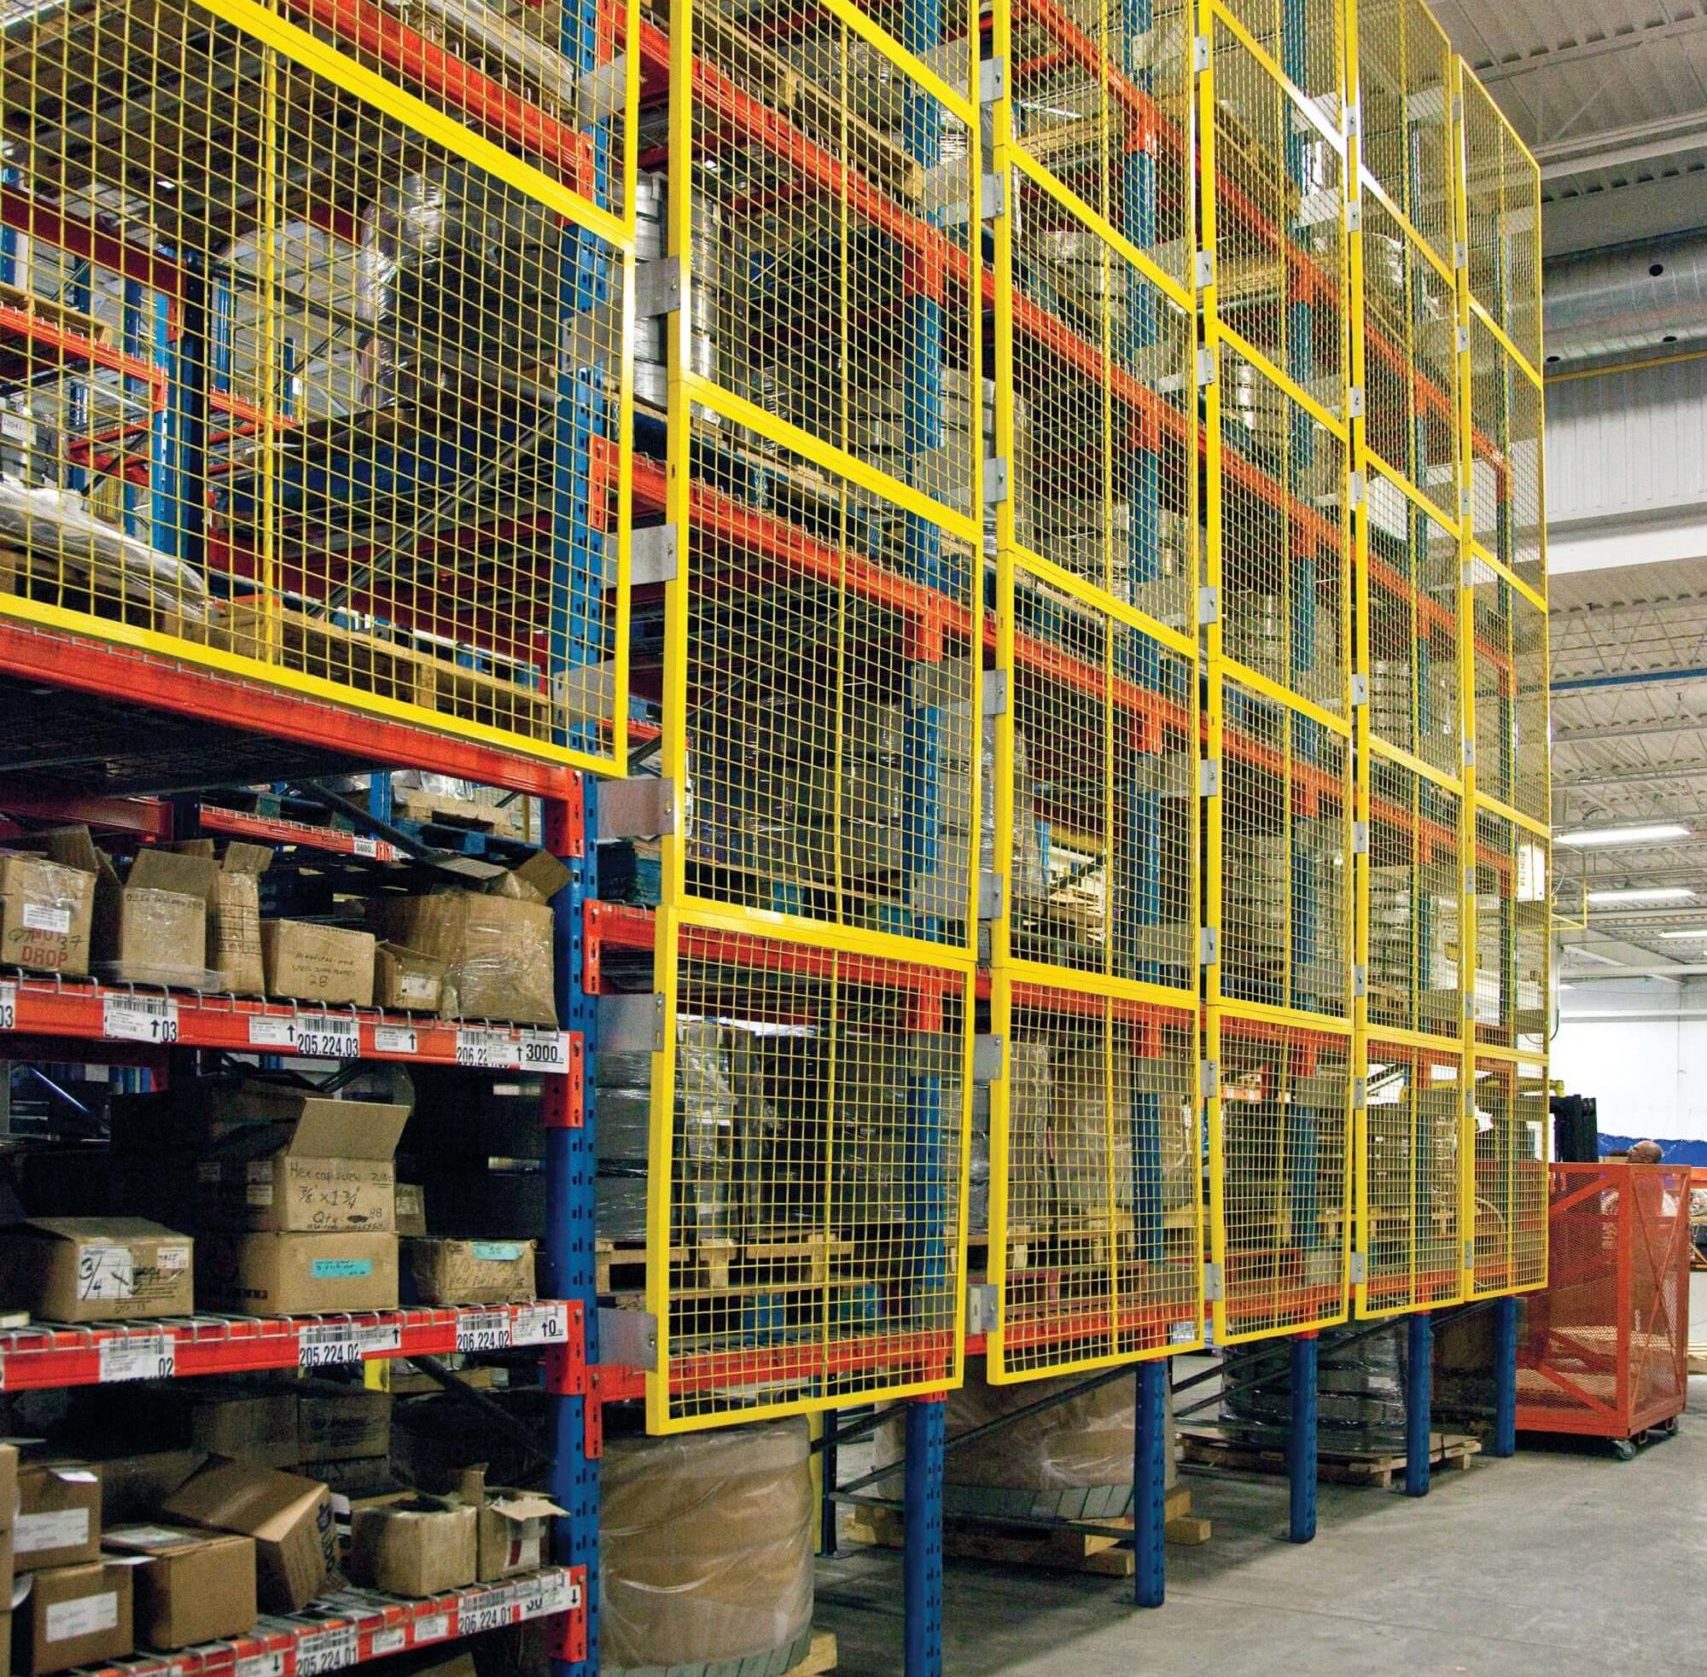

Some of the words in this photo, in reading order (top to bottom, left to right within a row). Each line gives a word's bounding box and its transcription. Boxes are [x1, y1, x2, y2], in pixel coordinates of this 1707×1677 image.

[162, 1020, 177, 1042] 03
[297, 1033, 359, 1058] 205.224.03
[526, 1043, 558, 1063] 3000
[457, 1330, 510, 1352] 206.224.02
[299, 1342, 360, 1366] 205.224.02
[158, 1356, 174, 1378] 02
[459, 1606, 513, 1634] 206.224.01
[297, 1647, 358, 1676] 205.224.01
